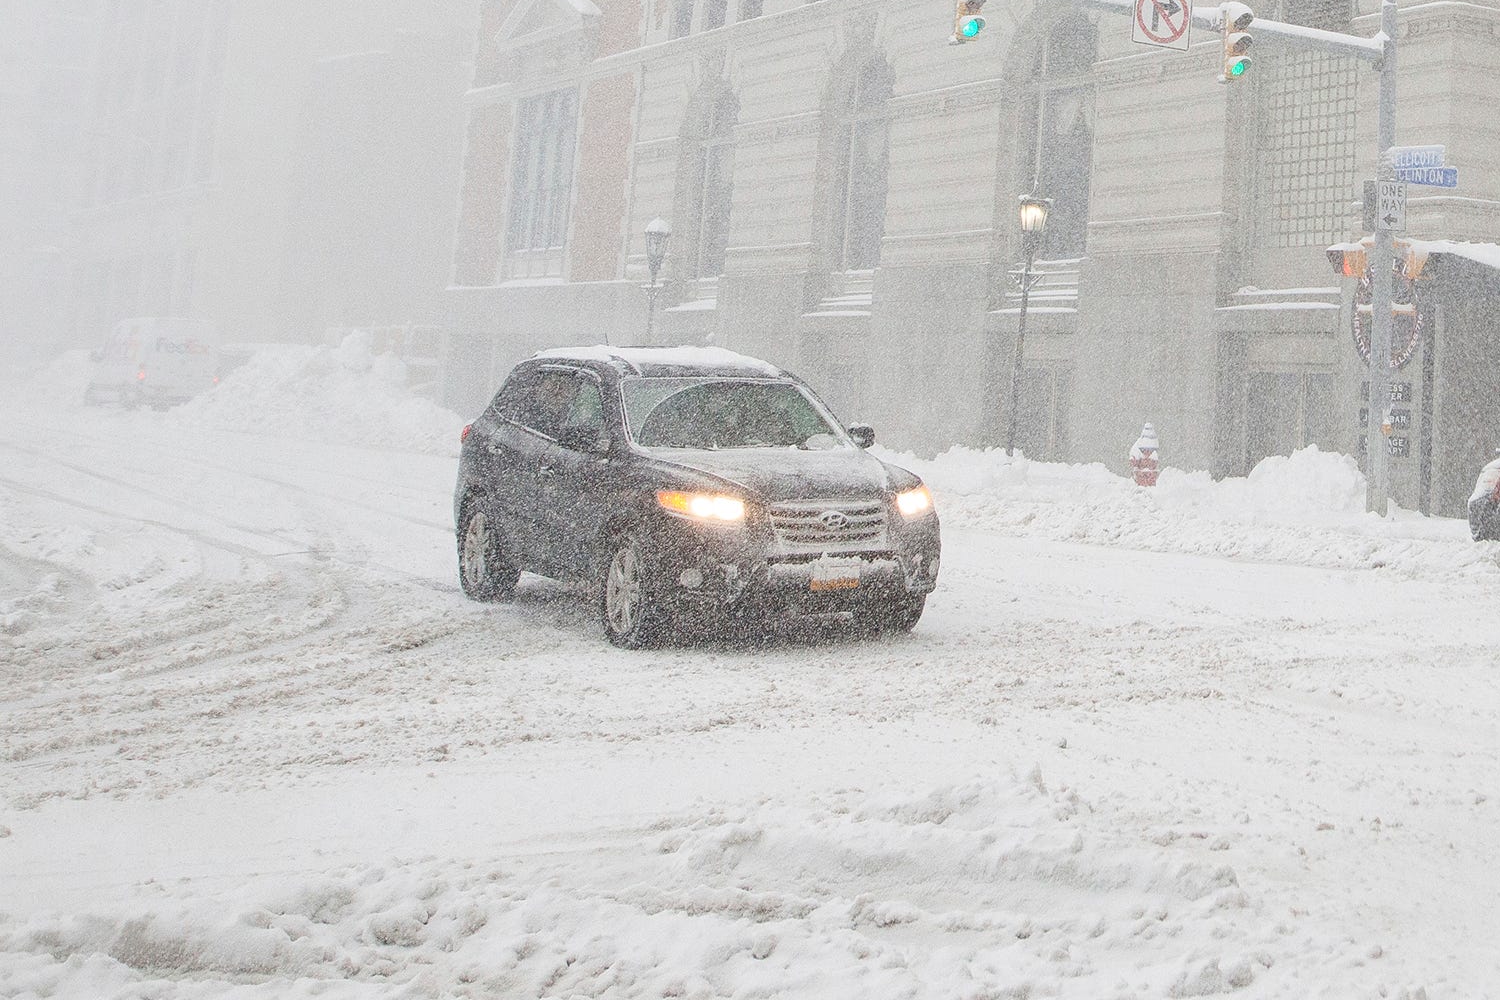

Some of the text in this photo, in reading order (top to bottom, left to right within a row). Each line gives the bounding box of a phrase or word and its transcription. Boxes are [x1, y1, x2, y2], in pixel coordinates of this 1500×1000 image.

[1395, 151, 1436, 167] ELLICOTT
[1398, 169, 1444, 184] CLINTON
[1381, 185, 1403, 198] ONE
[1381, 199, 1404, 212] WAY
[156, 336, 209, 355] FedEx
[1389, 332, 1419, 368] ELLNESS
